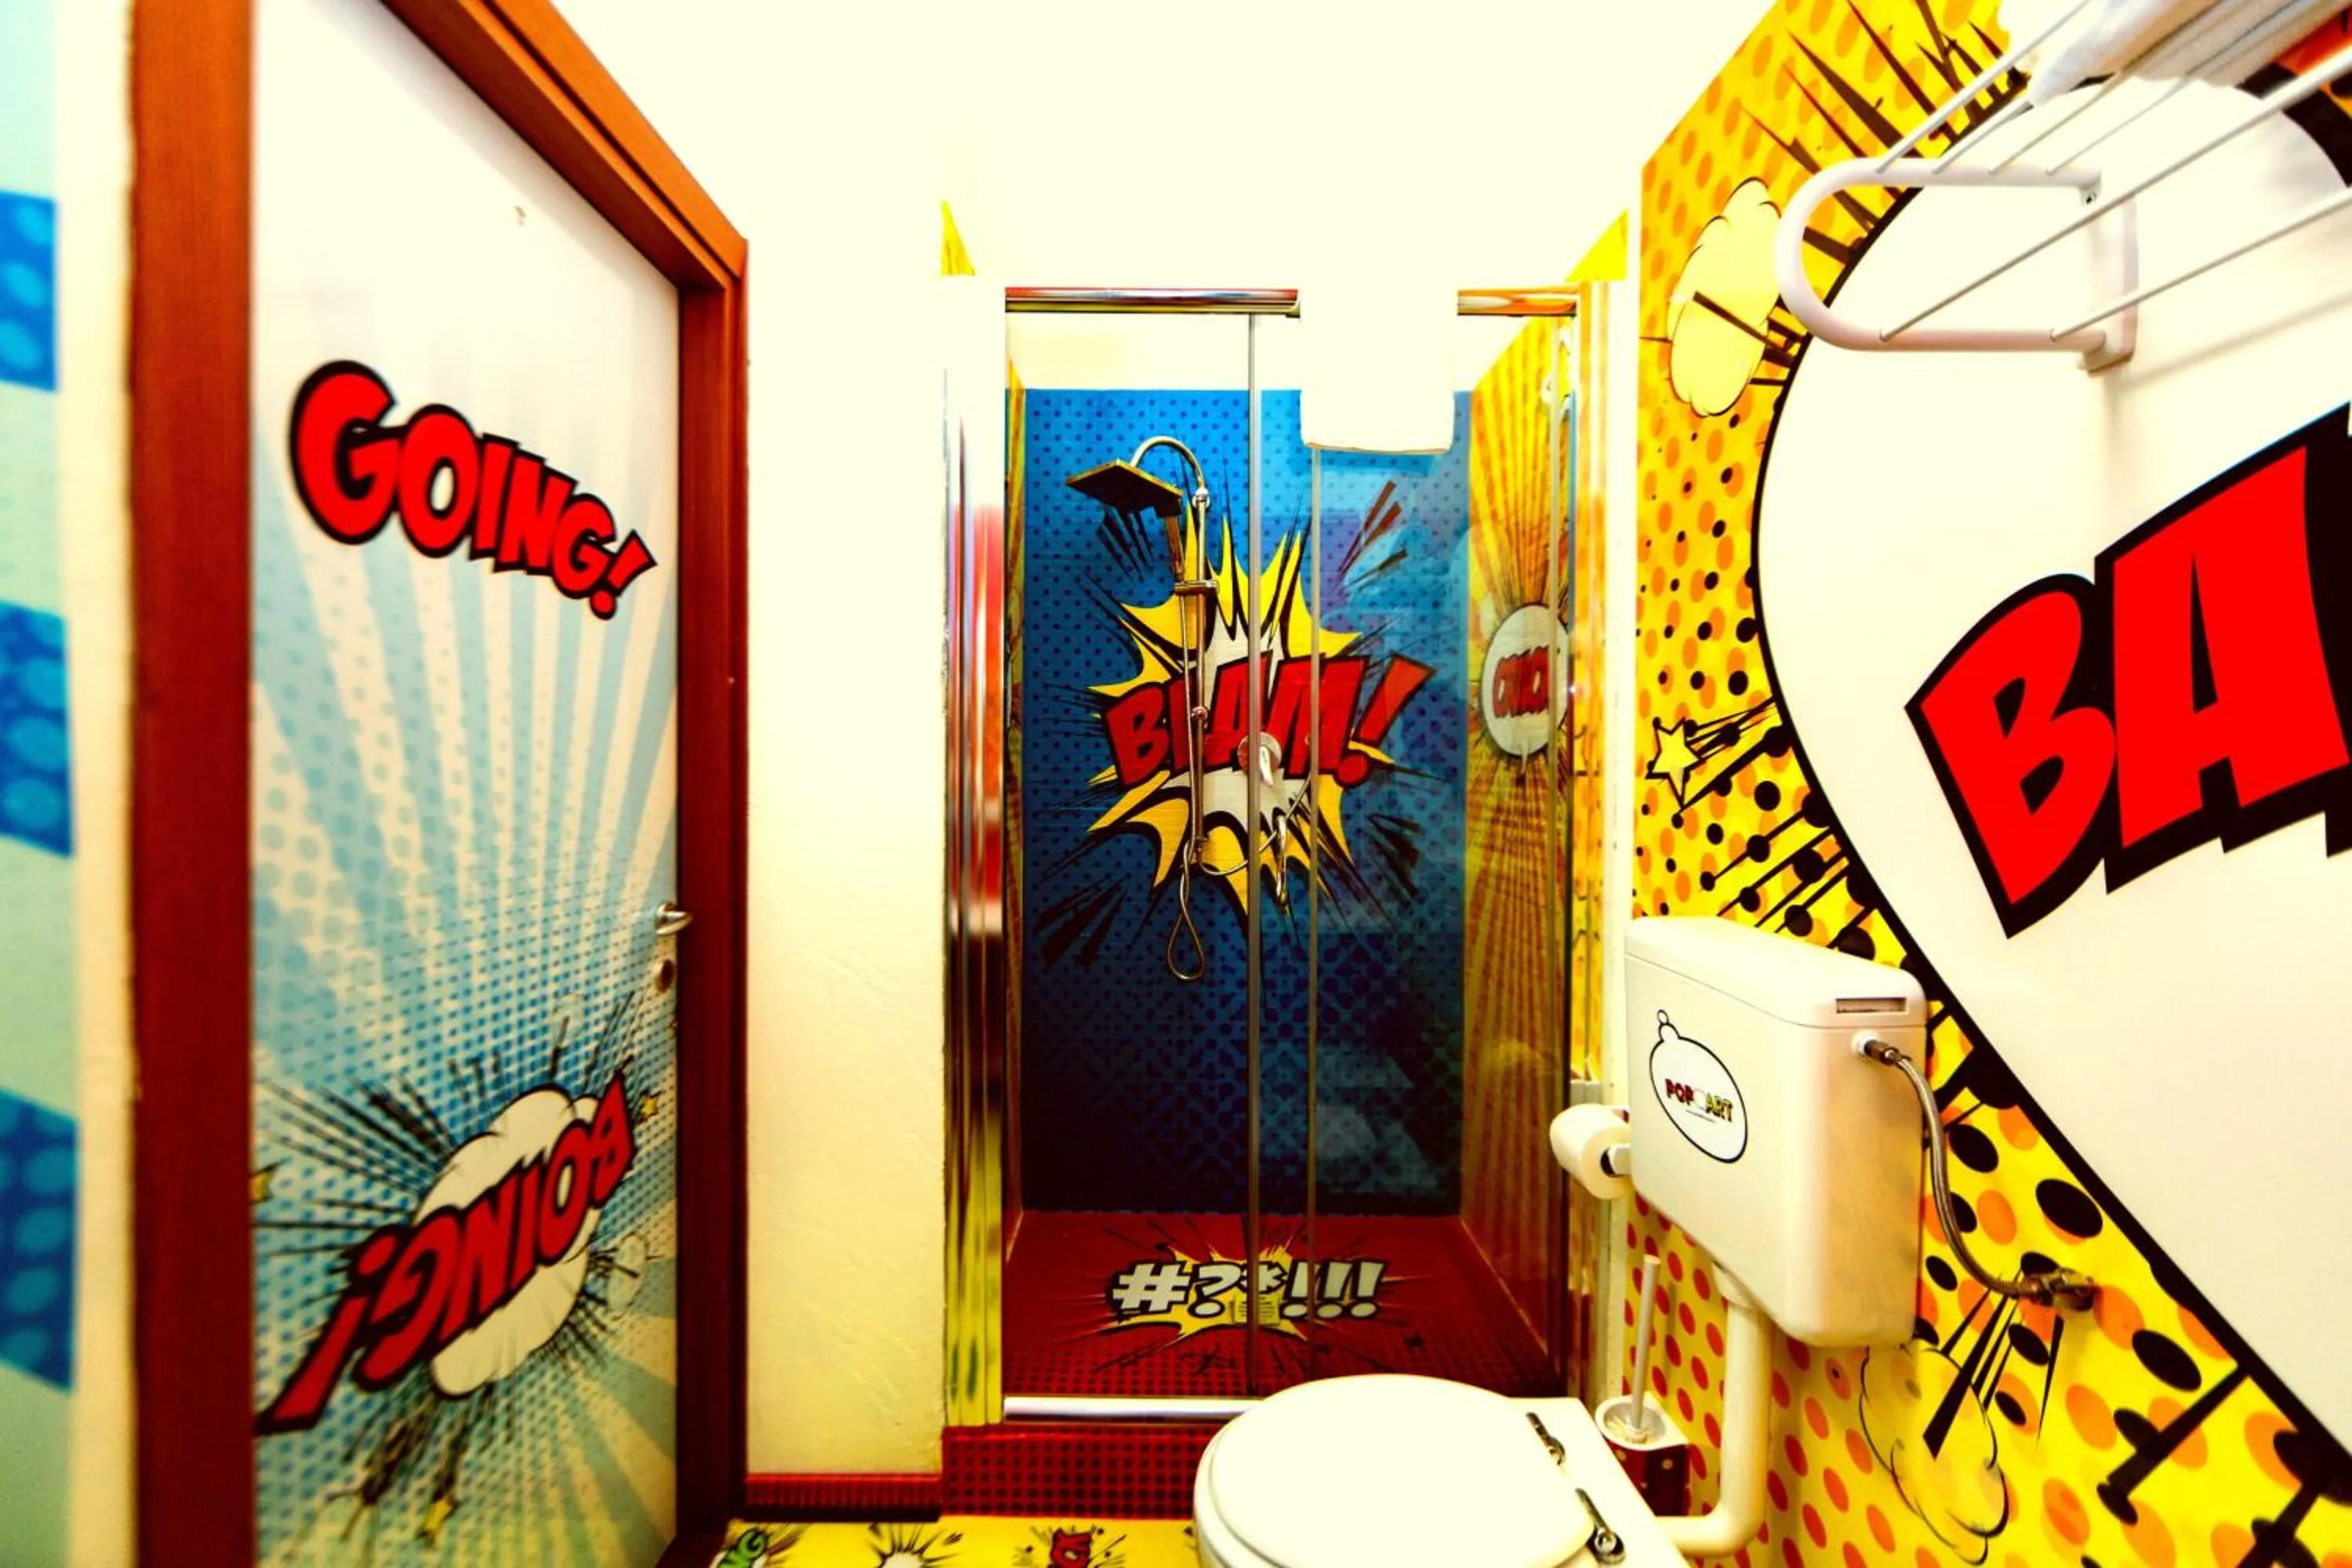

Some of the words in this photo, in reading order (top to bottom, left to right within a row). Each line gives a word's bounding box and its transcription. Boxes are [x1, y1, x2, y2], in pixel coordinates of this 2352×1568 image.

[289, 359, 658, 620] GOING!
[1101, 650, 1436, 792] BLAM!
[1904, 401, 2352, 938] BA
[1664, 1078, 1694, 1105] POP
[1705, 1092, 1733, 1123] ART
[252, 1069, 637, 1435] BOING!
